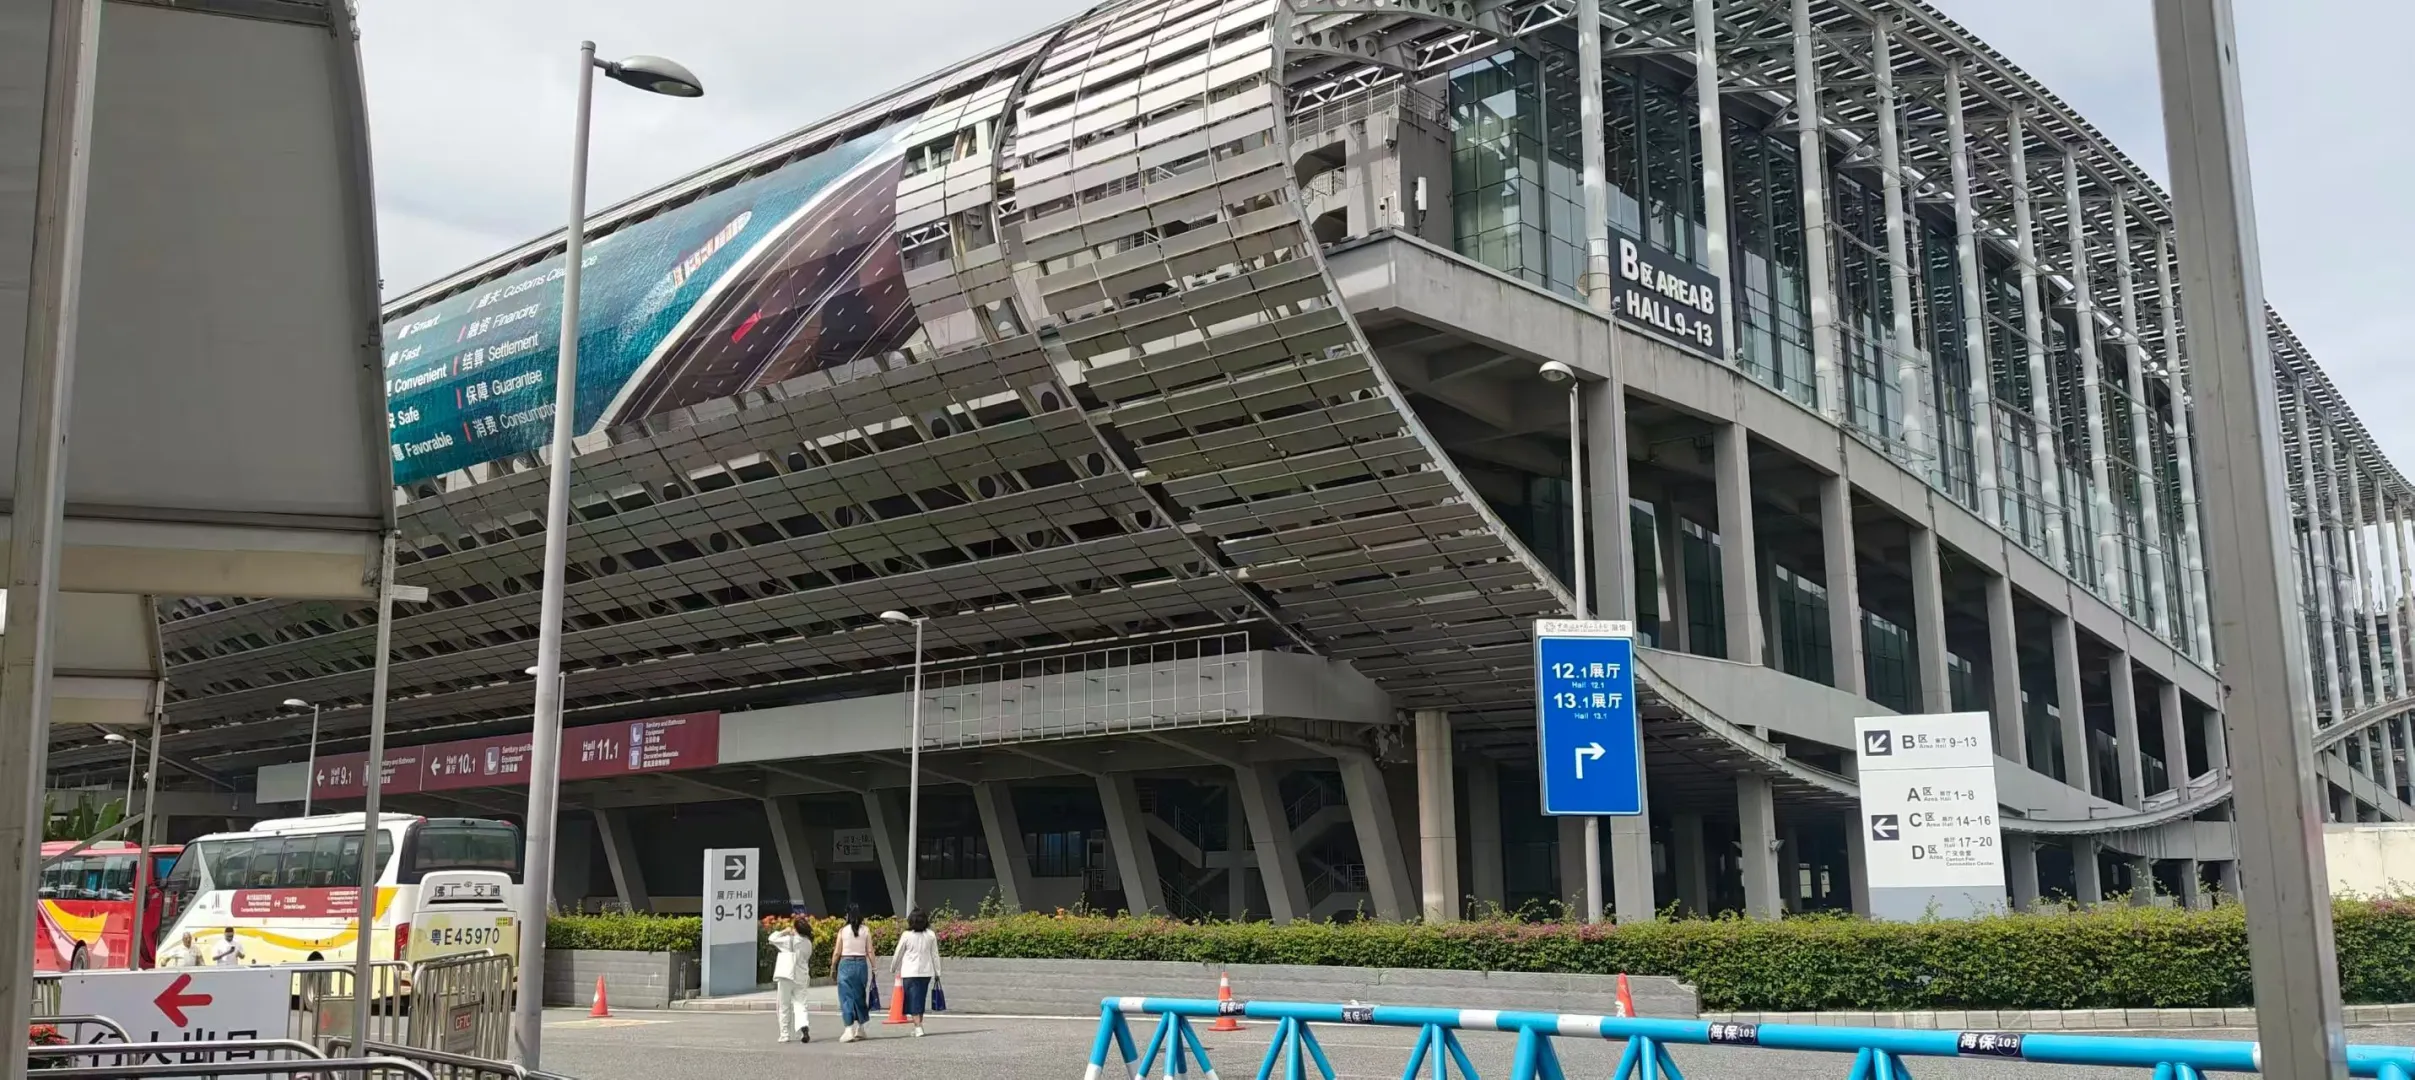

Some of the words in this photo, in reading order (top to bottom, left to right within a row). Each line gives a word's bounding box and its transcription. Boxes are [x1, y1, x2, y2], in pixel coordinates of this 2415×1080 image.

[503, 275, 546, 298] Customs
[411, 314, 440, 334] Smart
[493, 303, 539, 328] Financing
[400, 344, 421, 362] Fast
[462, 348, 484, 370] 结算
[488, 332, 539, 361] Settlement
[394, 363, 447, 392] Convenient
[466, 382, 490, 405] 保障
[492, 370, 543, 396] Guarantee
[398, 406, 420, 425] Safe
[472, 415, 500, 438] 消费
[500, 401, 557, 428] Consumptio
[404, 432, 454, 457] Favorable
[583, 741, 596, 751] Hall
[446, 755, 458, 765] Hall
[717, 890, 735, 900] 展厅
[736, 890, 753, 899] Hall
[715, 903, 753, 921] 9-13
[1711, 1024, 1739, 1040] 海保
[1739, 1028, 1755, 1038] 103
[1960, 1033, 1997, 1050] 海保
[1997, 1037, 2018, 1048] 103
[89, 1028, 258, 1067] 行人出口
